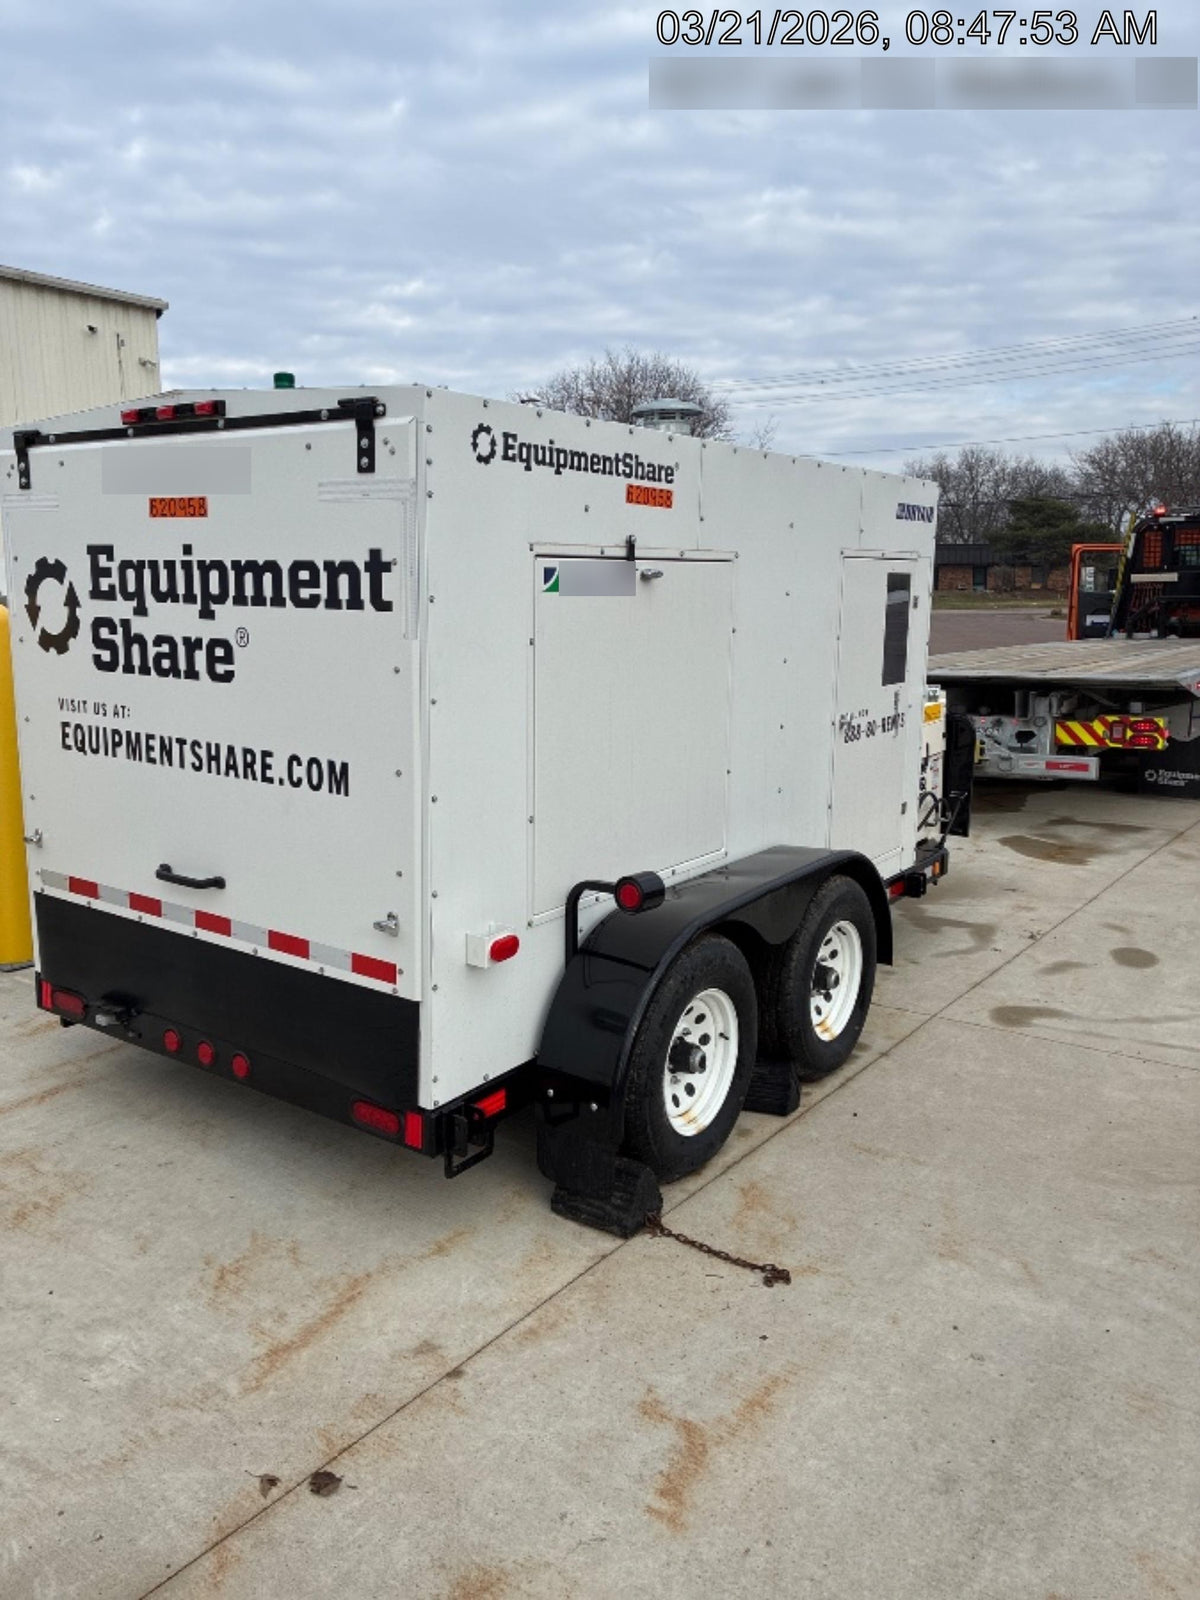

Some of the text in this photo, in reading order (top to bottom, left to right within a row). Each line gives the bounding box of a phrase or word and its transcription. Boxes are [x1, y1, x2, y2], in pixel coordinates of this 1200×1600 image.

[150, 497, 207, 517] 620958
[627, 484, 672, 508] 620958
[86, 544, 393, 620] Equipment
[57, 697, 131, 720] VISIT US AT:
[60, 721, 350, 797] EQUIPMENTSHARE.COM
